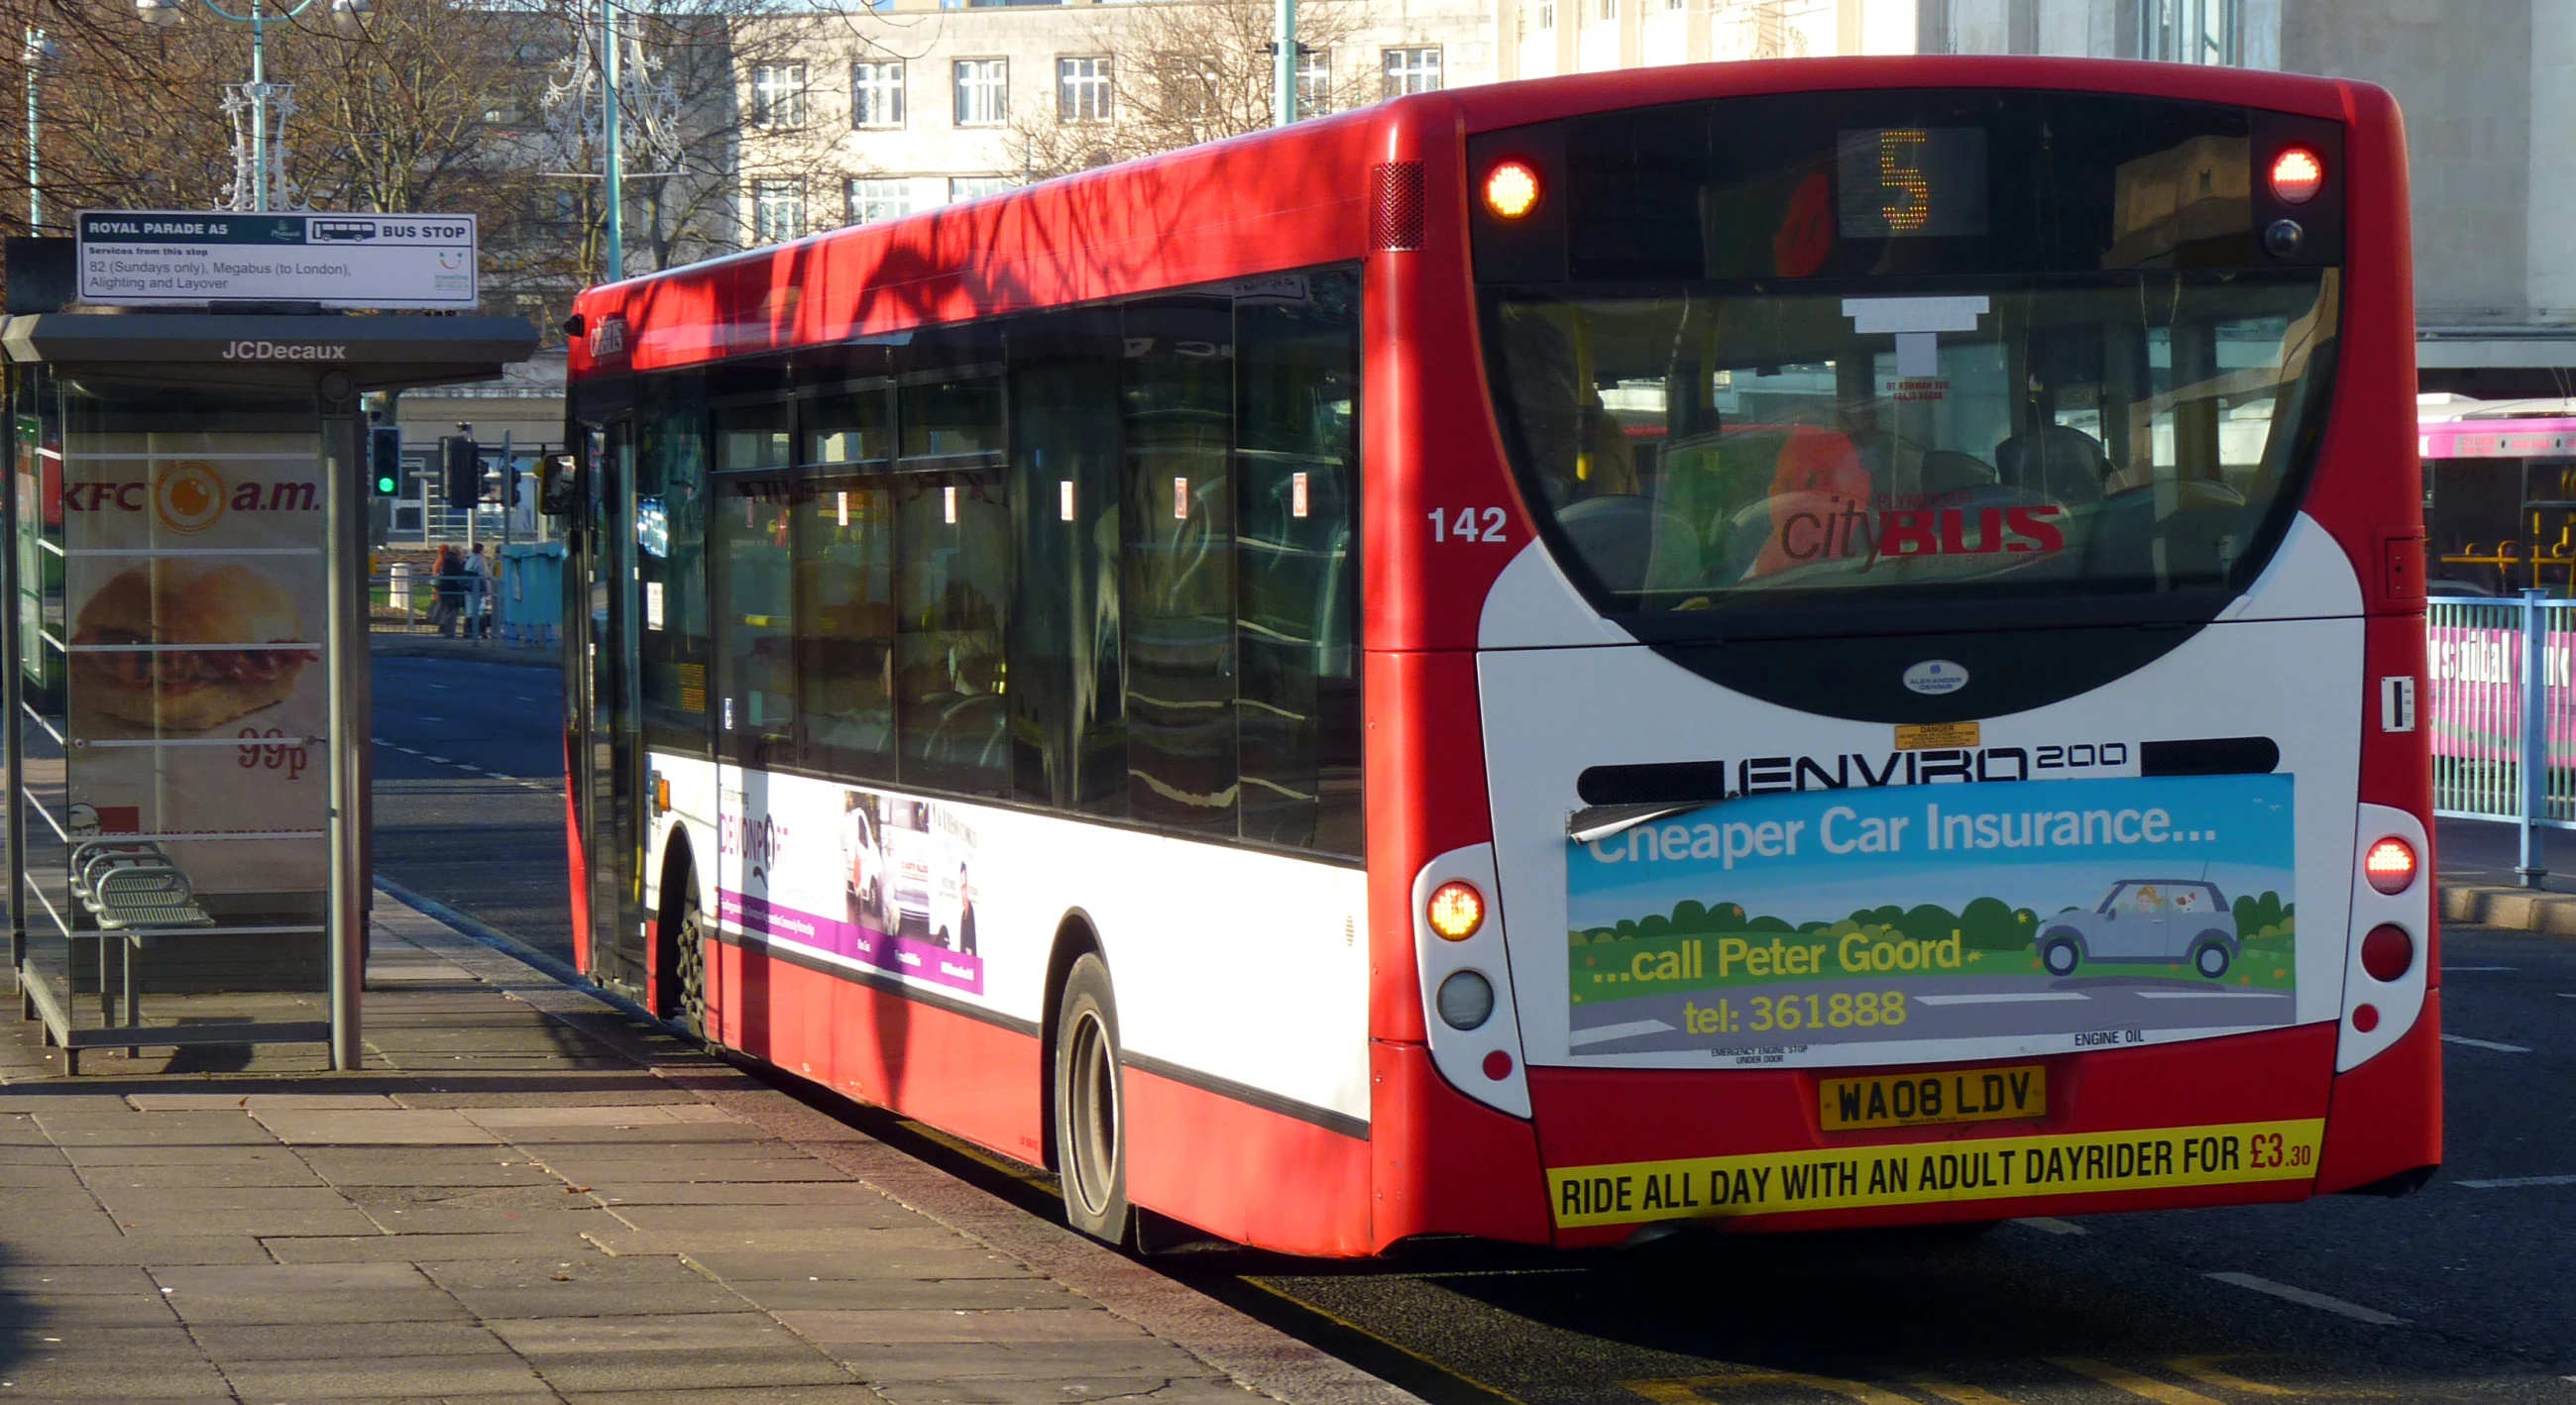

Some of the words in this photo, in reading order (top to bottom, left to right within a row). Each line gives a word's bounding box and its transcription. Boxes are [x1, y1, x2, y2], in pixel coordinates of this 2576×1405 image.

[1880, 130, 1929, 230] 5
[88, 222, 140, 234] ROYAL
[143, 223, 204, 235] PARADE
[208, 224, 229, 235] A5
[382, 225, 416, 238] BUS
[421, 226, 466, 238] STOP
[88, 247, 133, 256] Services
[136, 247, 161, 256] from
[163, 247, 182, 256] this
[185, 248, 208, 258] stop
[88, 261, 106, 272] 82
[109, 261, 169, 275] (Sundays
[173, 262, 209, 276] only),
[213, 263, 272, 276] Megabus
[275, 264, 292, 277] (to
[295, 264, 352, 277] London),
[89, 276, 146, 291] Alighting
[149, 277, 173, 289] and
[176, 277, 229, 291] Layover
[221, 341, 347, 361] JCDecaux
[64, 482, 146, 512] KFC
[230, 481, 321, 512] a.m.
[1427, 506, 1508, 543] 142
[1920, 725, 1955, 734] DANGER
[237, 726, 308, 781] 99p
[1738, 747, 2029, 797] ENVIRO
[2036, 742, 2128, 769] 200
[1819, 806, 1909, 855] Car
[1927, 804, 2216, 850] Insurance...
[1593, 939, 1703, 983] ...call
[1718, 936, 1826, 977] Peter
[1839, 928, 1961, 972] Goord
[1683, 998, 1739, 1035] tel:
[1749, 990, 1907, 1032] 361888
[2074, 1030, 2120, 1046] ENGINE
[2125, 1029, 2145, 1043] OIL
[1711, 1047, 1756, 1057] EMERGENCY
[1757, 1046, 1785, 1055] ENGINE
[1788, 1044, 1808, 1053] STOP
[1736, 1055, 1761, 1064] UNDER
[1763, 1054, 1784, 1063] DOOR
[1838, 1078, 1943, 1123] WA08
[1956, 1071, 2031, 1115] LDV
[1561, 1176, 1632, 1216] RIDE
[1641, 1172, 1699, 1210] ALL
[1710, 1166, 1771, 1206] DAY
[1780, 1160, 1858, 1201] WITH
[1867, 1157, 1909, 1195] AN
[1918, 1149, 2016, 1191] ADULT
[2025, 1139, 2174, 1185] DAYRIDER
[2183, 1135, 2240, 1174] FOR
